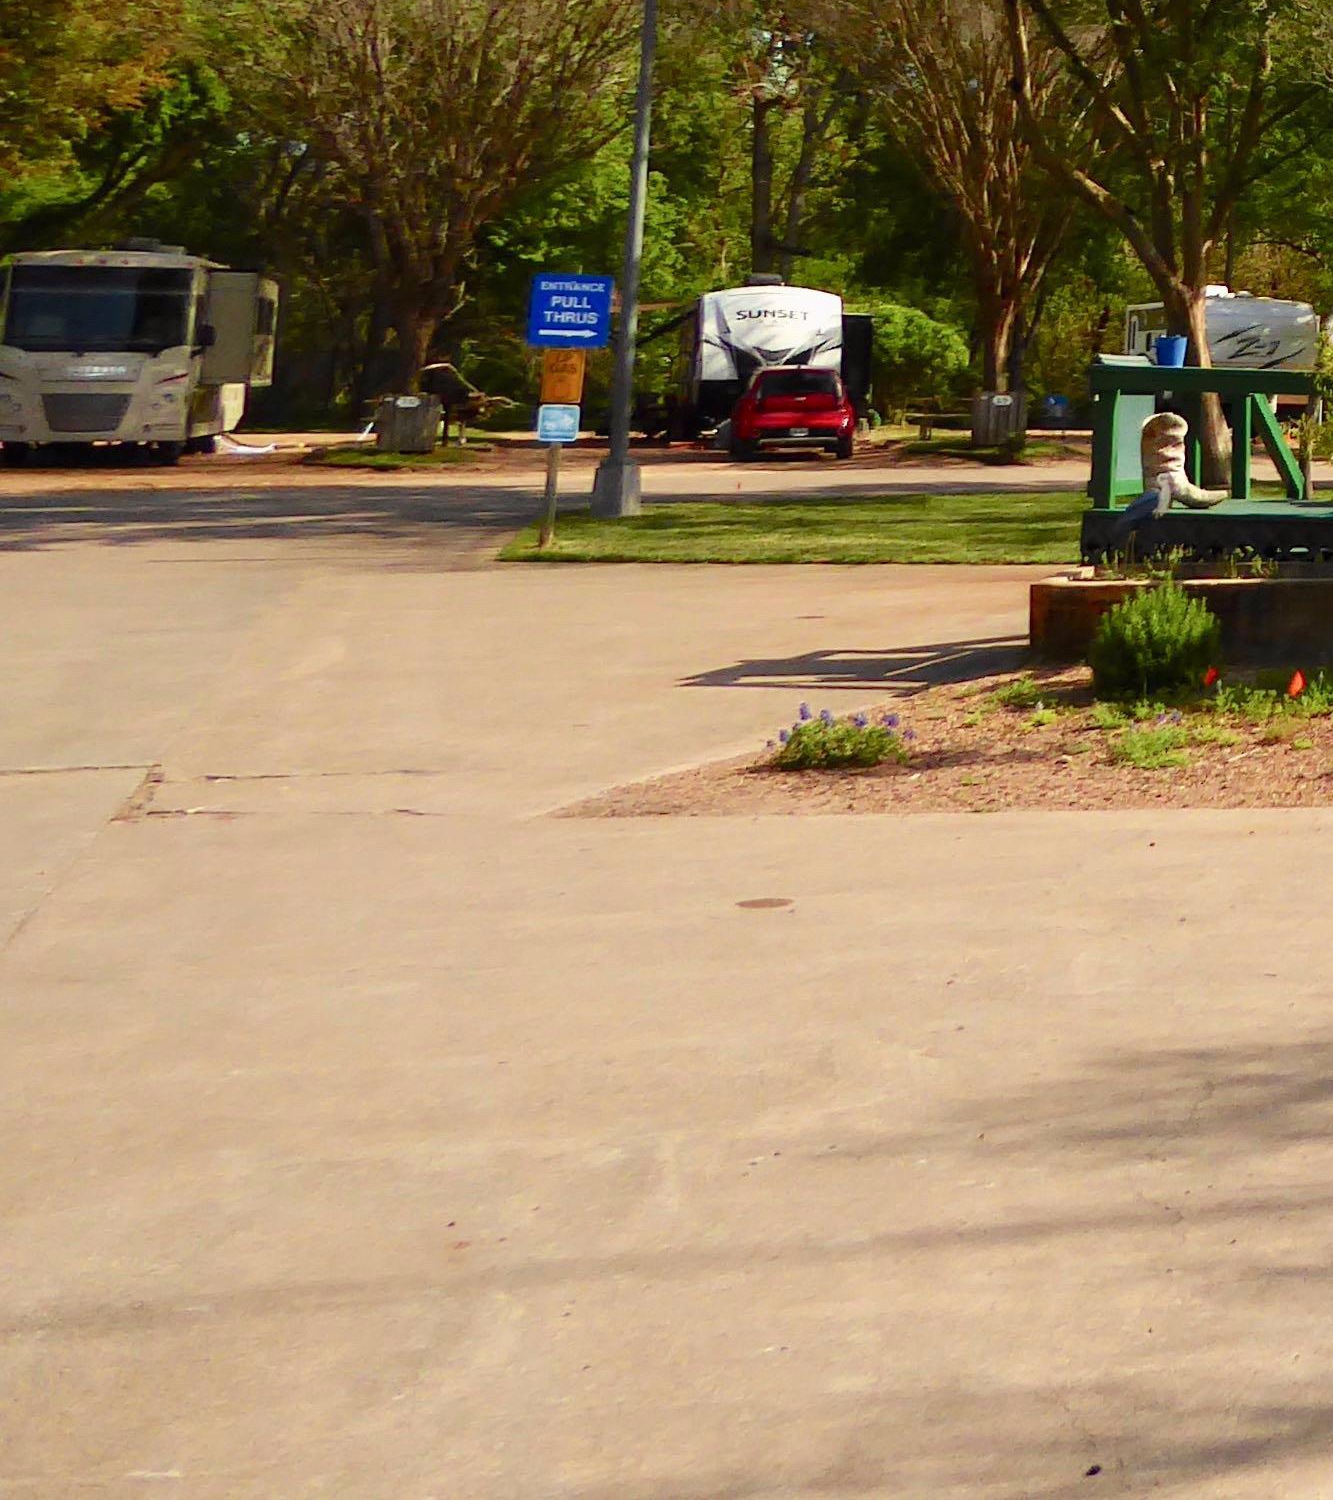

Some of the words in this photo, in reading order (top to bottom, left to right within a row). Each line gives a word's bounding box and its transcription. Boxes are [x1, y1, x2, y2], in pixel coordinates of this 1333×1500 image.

[540, 280, 605, 293] ENTRANCE
[551, 295, 592, 309] PULL
[543, 310, 599, 325] THRUS
[735, 309, 809, 321] SUNSET
